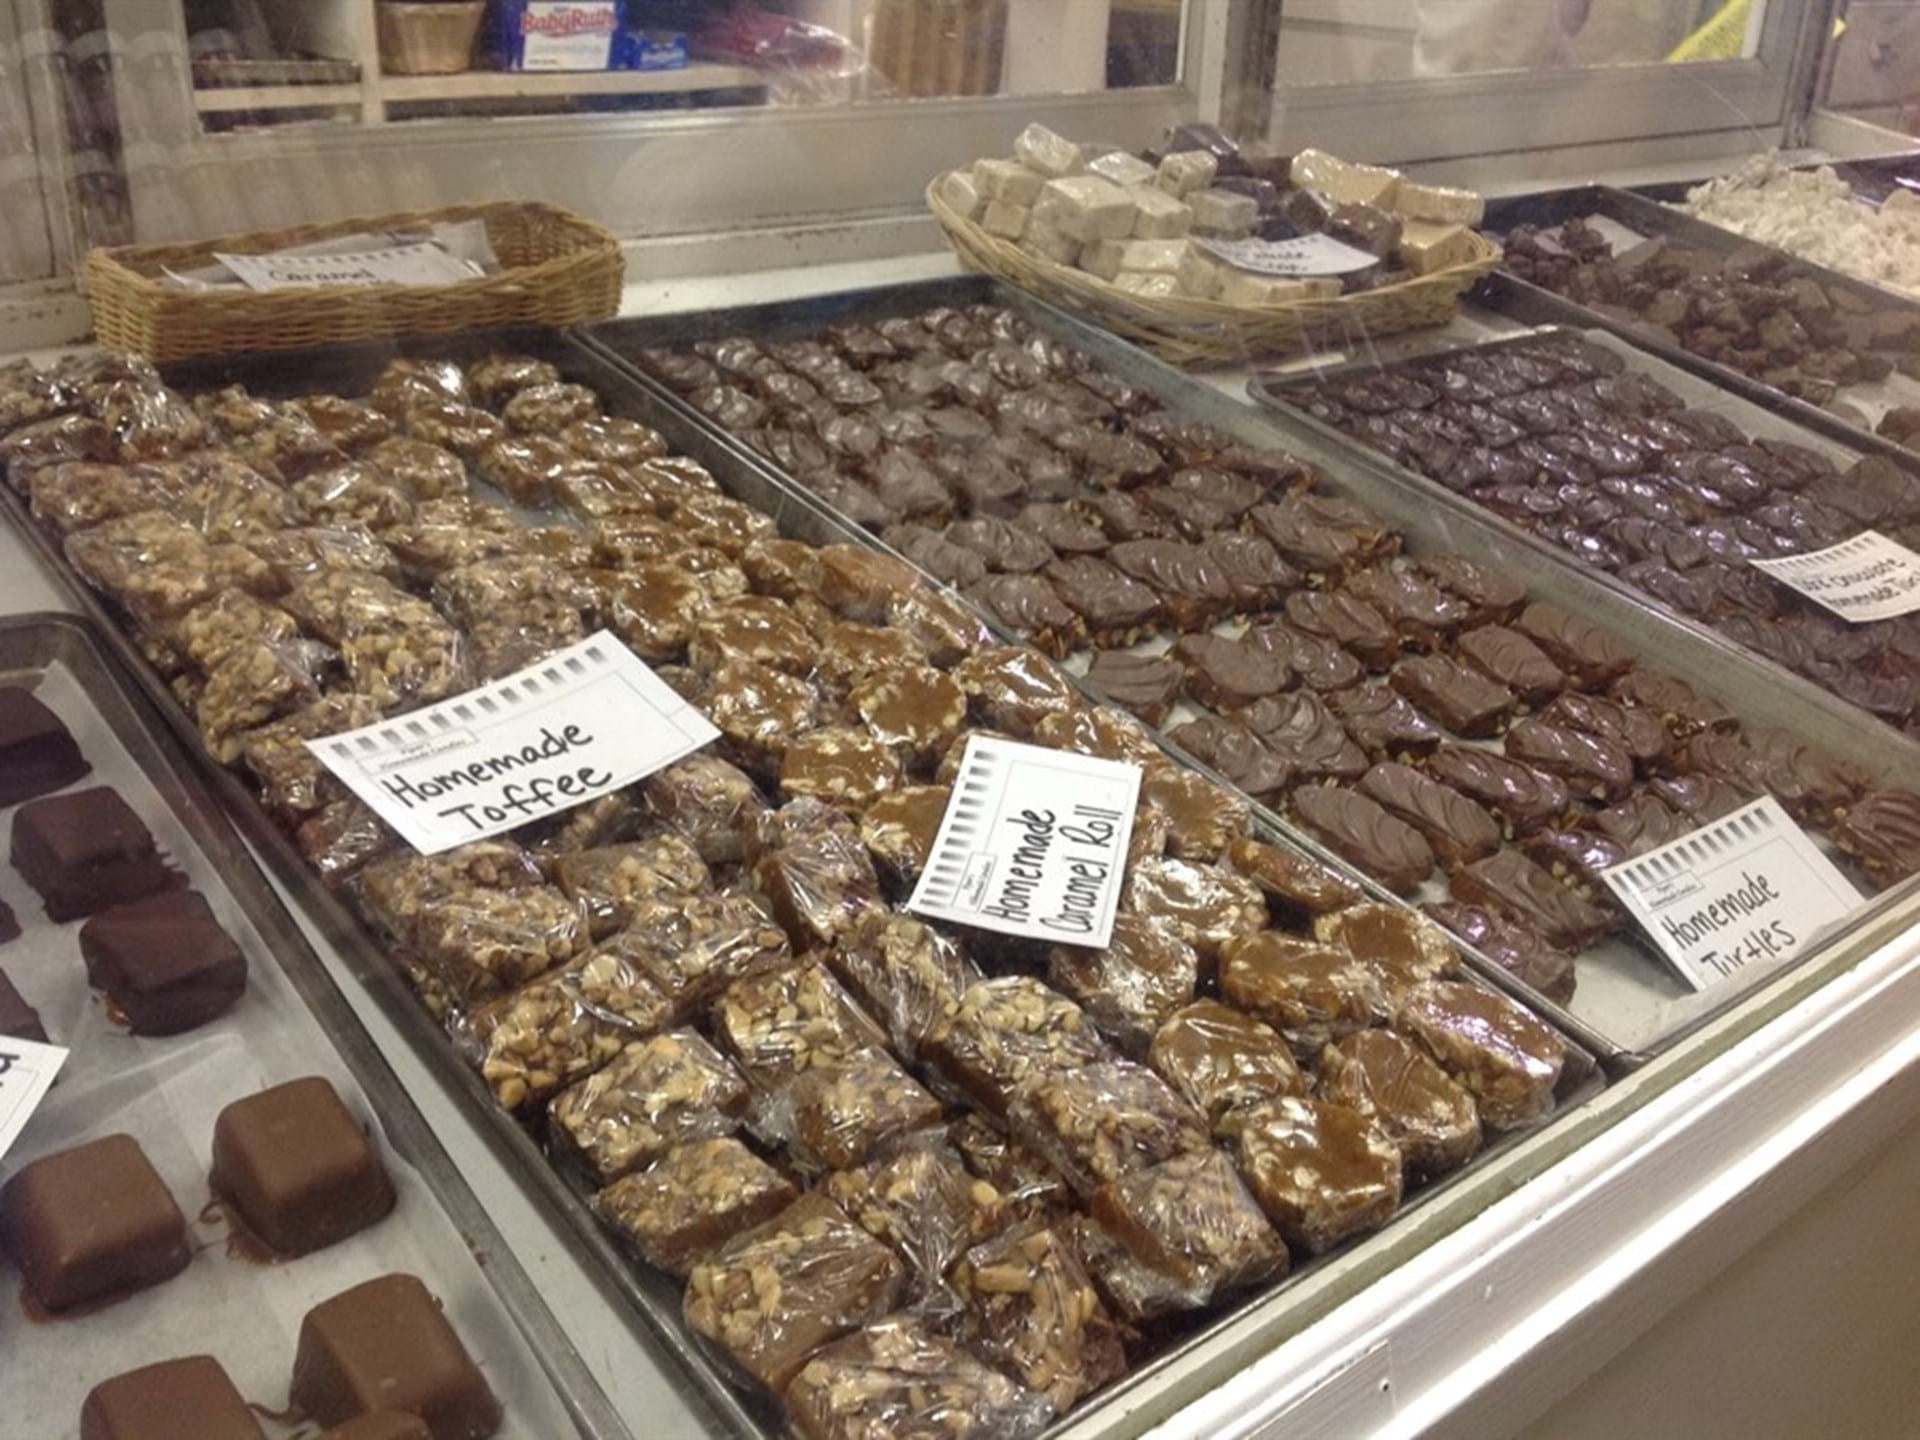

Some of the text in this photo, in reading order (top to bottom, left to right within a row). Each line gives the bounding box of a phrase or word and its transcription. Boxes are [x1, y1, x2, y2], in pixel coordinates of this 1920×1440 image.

[268, 267, 376, 282] Caramel
[381, 724, 593, 808] Homemade
[438, 766, 613, 829] Toffee
[981, 808, 1057, 923] Homemade
[1038, 804, 1123, 933] Caramel Roll
[1661, 871, 1780, 950] Homemade
